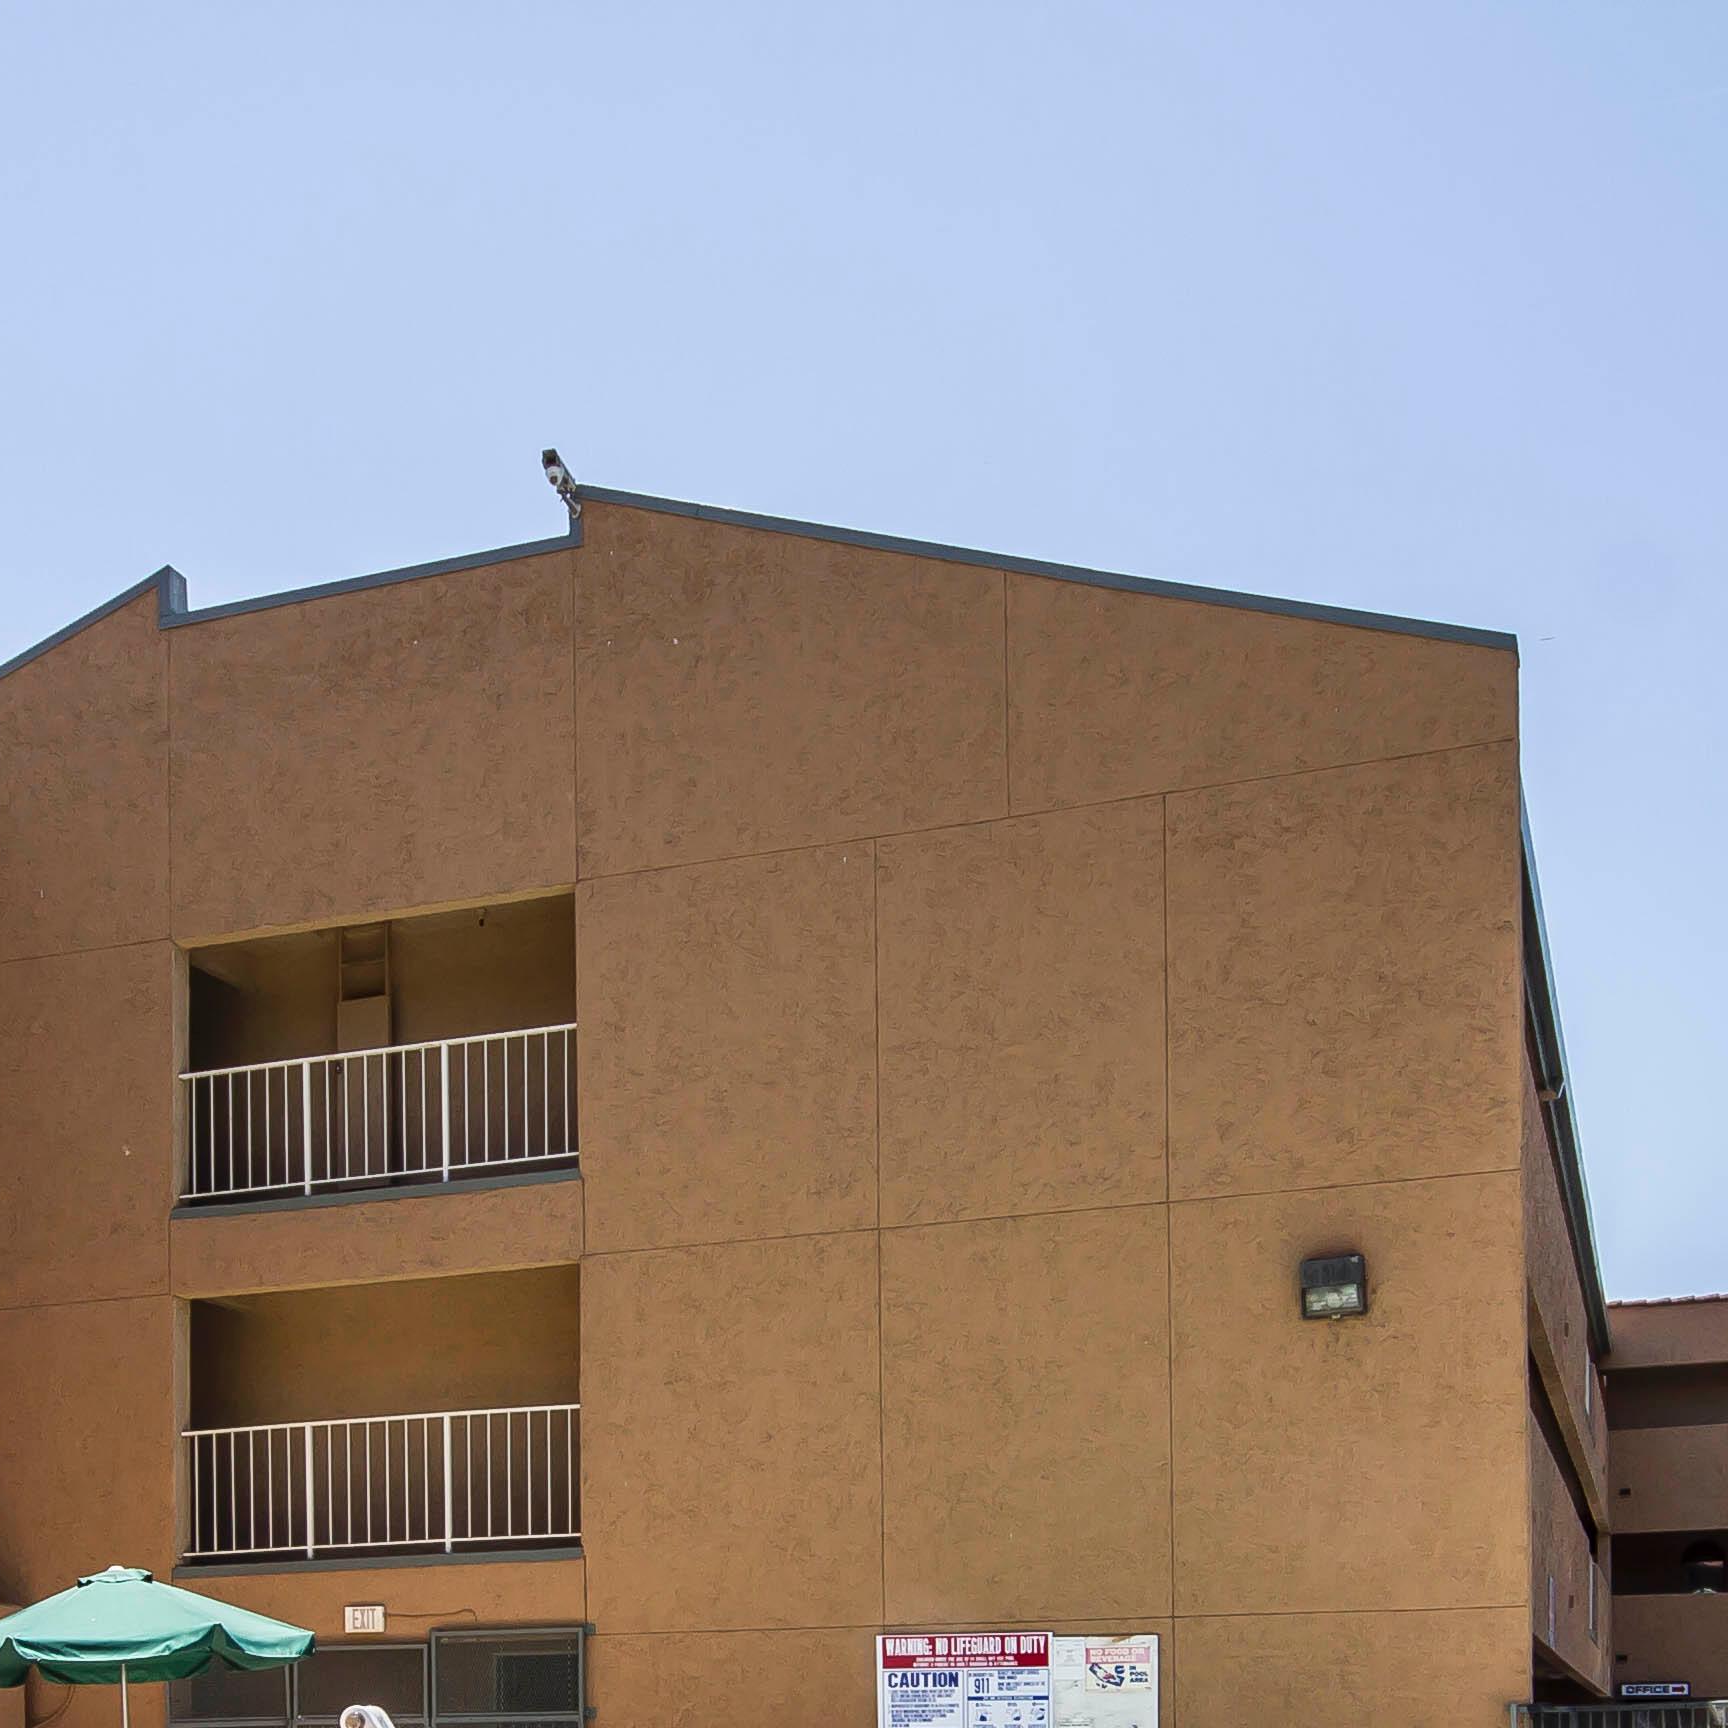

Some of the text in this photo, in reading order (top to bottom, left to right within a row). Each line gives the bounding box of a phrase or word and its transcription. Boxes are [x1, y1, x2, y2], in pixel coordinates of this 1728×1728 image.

[352, 1608, 376, 1630] EXIT
[885, 1635, 1046, 1657] WARNING: NO LIFEGUARD ON DUTY
[1089, 1648, 1103, 1656] NO
[1089, 1655, 1137, 1663] BEVERAGE
[887, 1671, 959, 1688] CAUTION
[974, 1677, 990, 1694] 911
[1625, 1686, 1670, 1694] OFFICE
